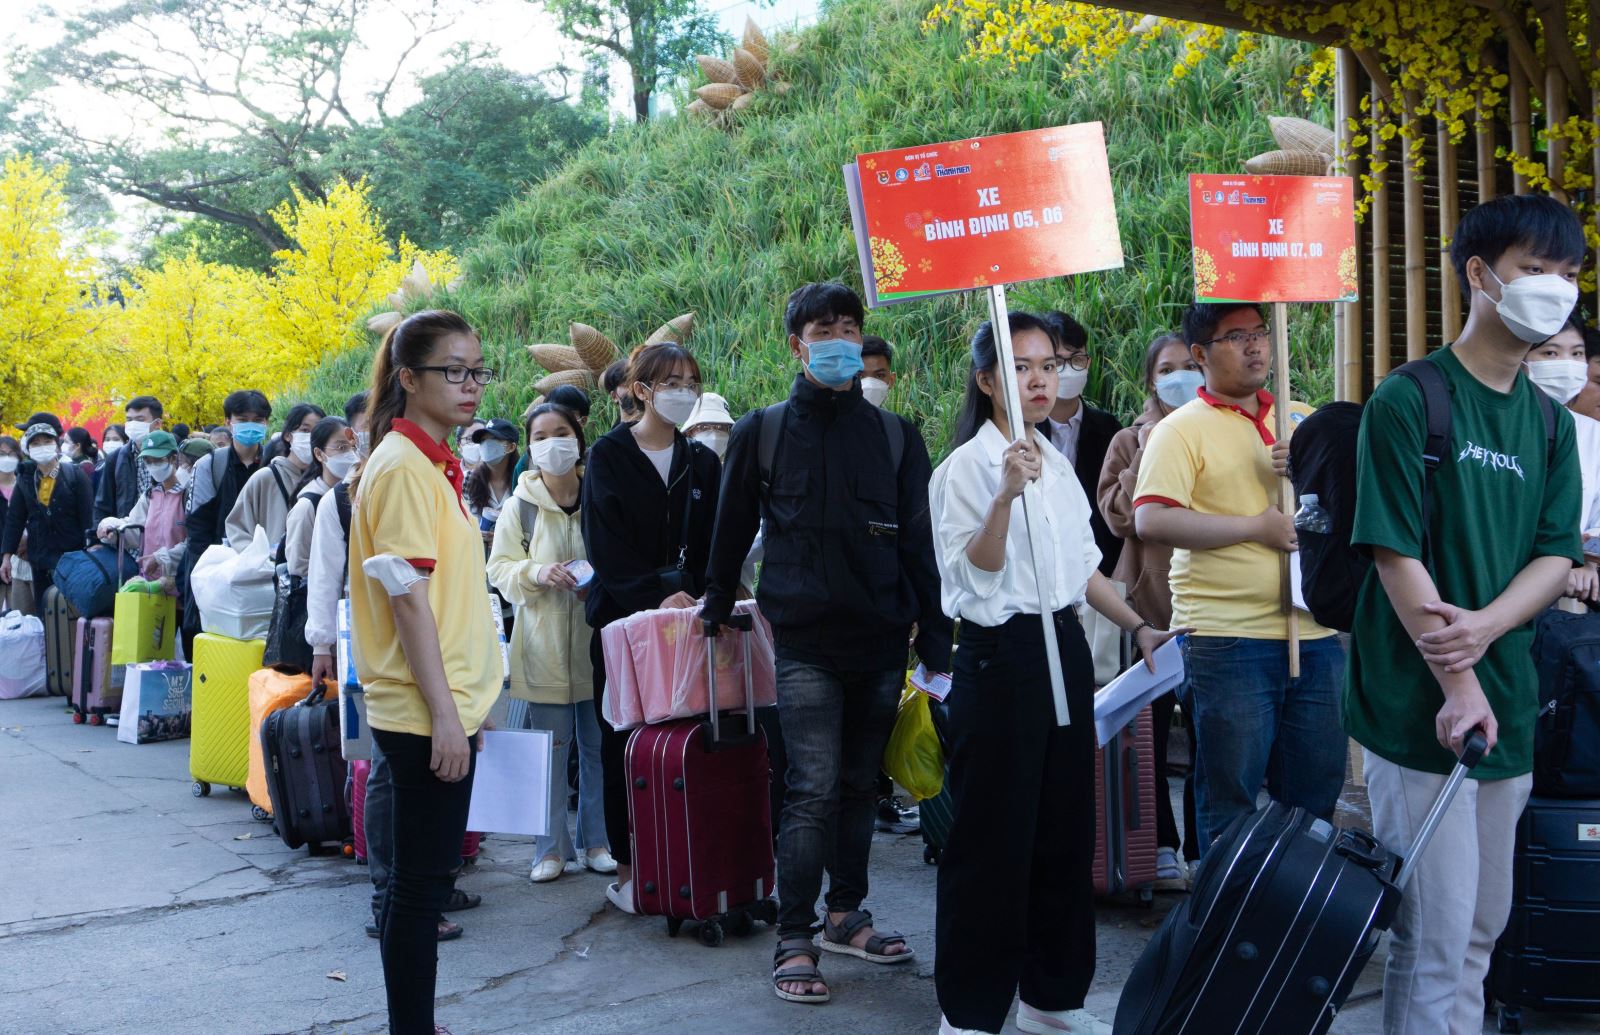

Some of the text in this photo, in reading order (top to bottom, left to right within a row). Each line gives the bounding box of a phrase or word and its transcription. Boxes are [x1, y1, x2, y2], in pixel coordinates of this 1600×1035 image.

[976, 187, 1000, 207] XE
[924, 207, 1064, 242] BÌNH ĐỊNH 05, 06
[1268, 218, 1285, 235] XE
[1231, 239, 1260, 257] BÌNH
[1261, 242, 1288, 260] ĐỊNH
[1291, 242, 1308, 260] 07,
[1460, 440, 1520, 472] HEY YOU
